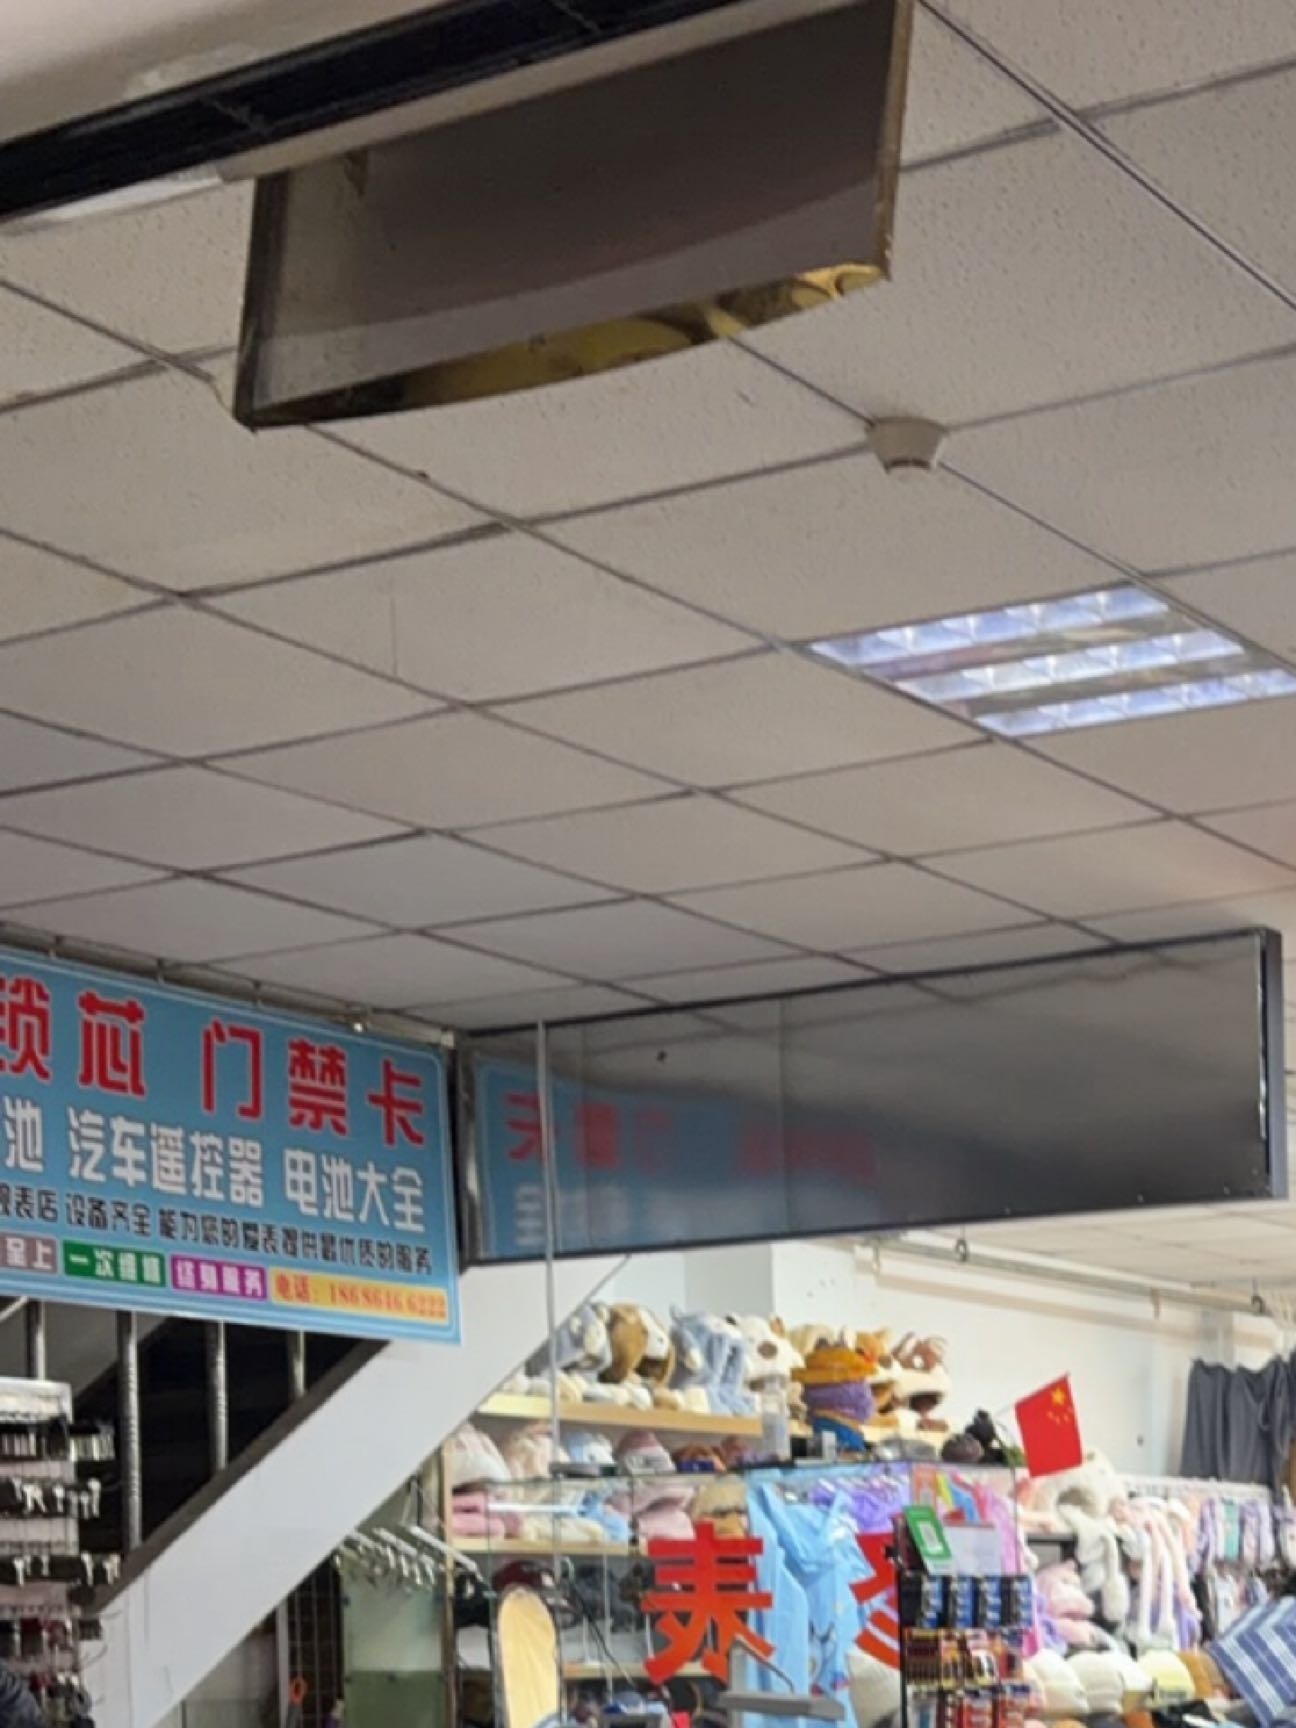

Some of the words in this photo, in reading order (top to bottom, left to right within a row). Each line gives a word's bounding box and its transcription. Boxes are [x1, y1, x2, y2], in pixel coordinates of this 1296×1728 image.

[0, 976, 146, 1097] 锁芯
[202, 1019, 425, 1148] 门禁卡
[66, 1191, 152, 1238] 设备齐全
[67, 1104, 264, 1209] 汽车遥控器
[281, 1147, 426, 1233] 电池大全
